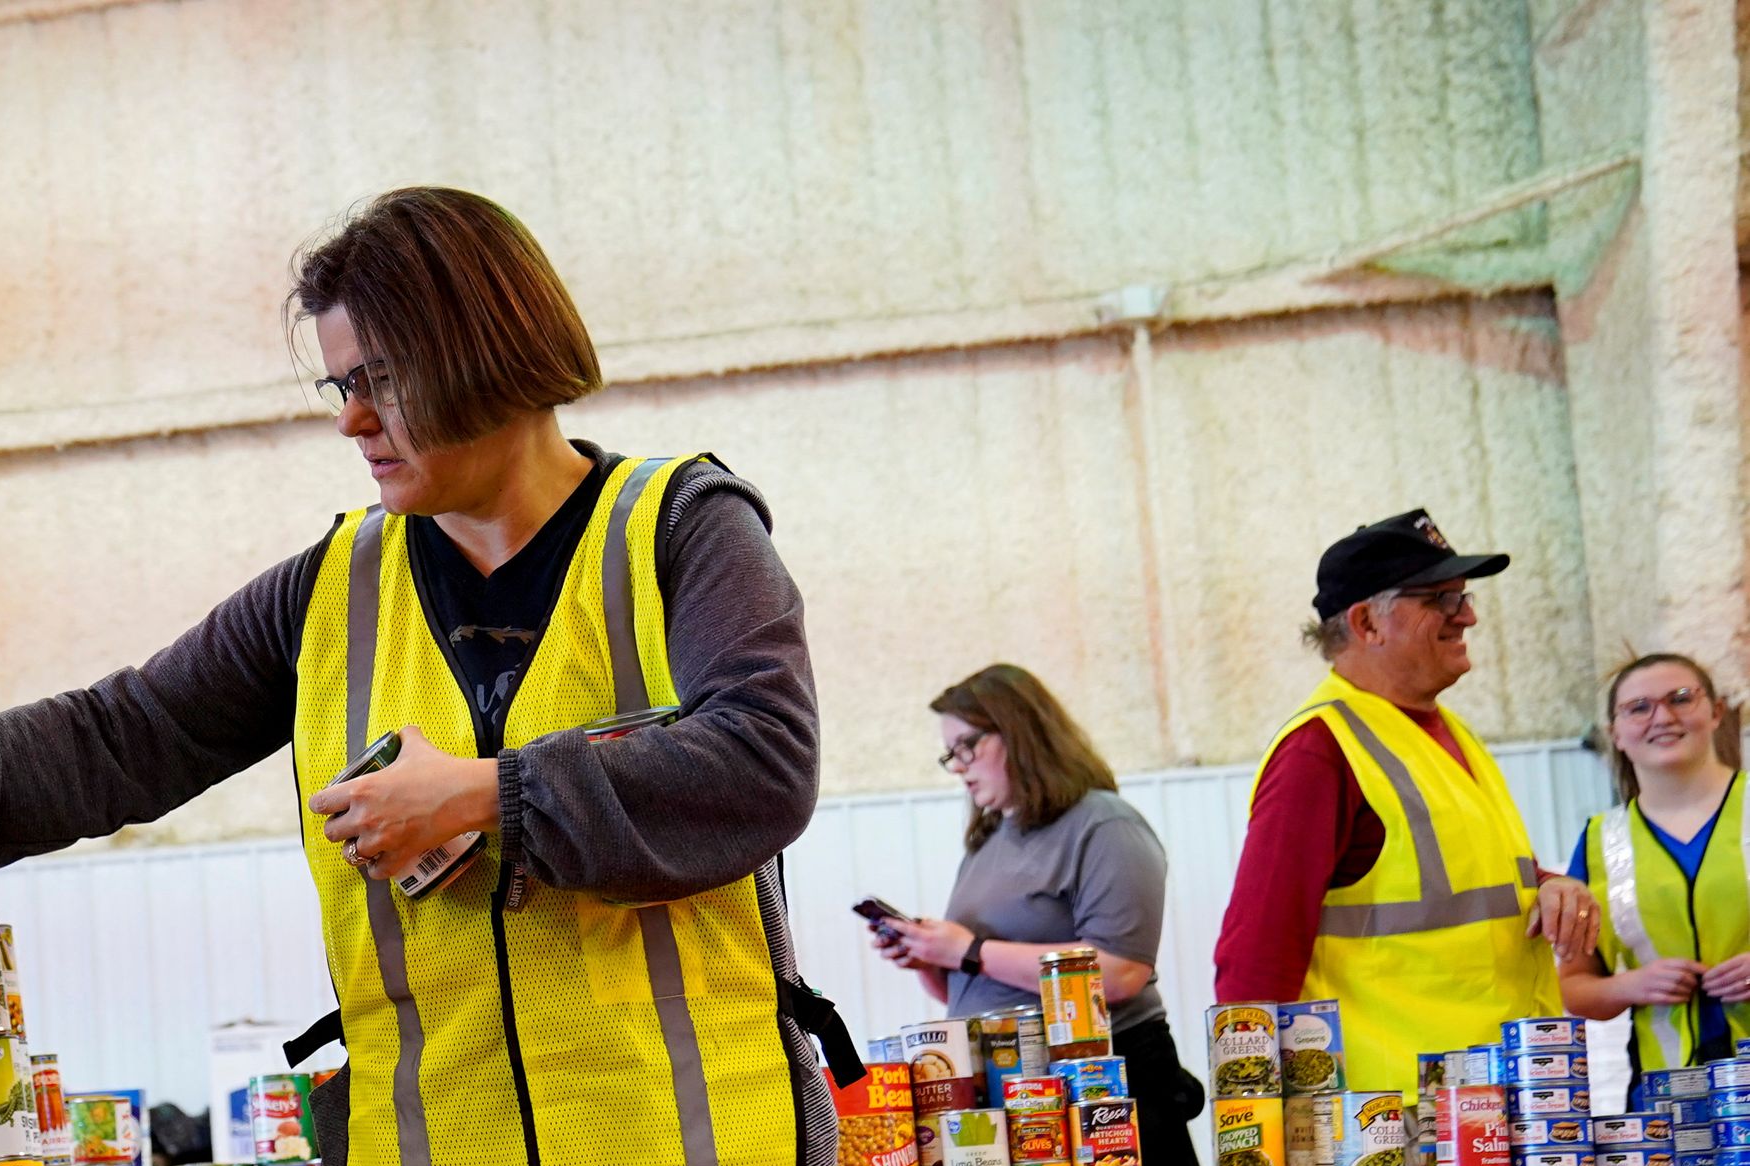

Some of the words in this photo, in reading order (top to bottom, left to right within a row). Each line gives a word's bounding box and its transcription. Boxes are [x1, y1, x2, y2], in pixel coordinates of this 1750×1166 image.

[509, 878, 524, 908] SAFETY
[907, 1031, 947, 1047] DELALLO
[1219, 1036, 1270, 1046] COLLARD
[1223, 1045, 1267, 1055] GREENS
[867, 1085, 913, 1109] Bean
[914, 1083, 952, 1097] BUTTER
[1091, 1106, 1128, 1126] Reese
[1219, 1111, 1254, 1128] Save
[1090, 1128, 1133, 1139] ARTICHOKE
[1021, 1140, 1052, 1152] OLIVES
[1098, 1137, 1129, 1146] HEARTS
[1219, 1136, 1260, 1153] PINACH
[1473, 1138, 1510, 1153] Salm
